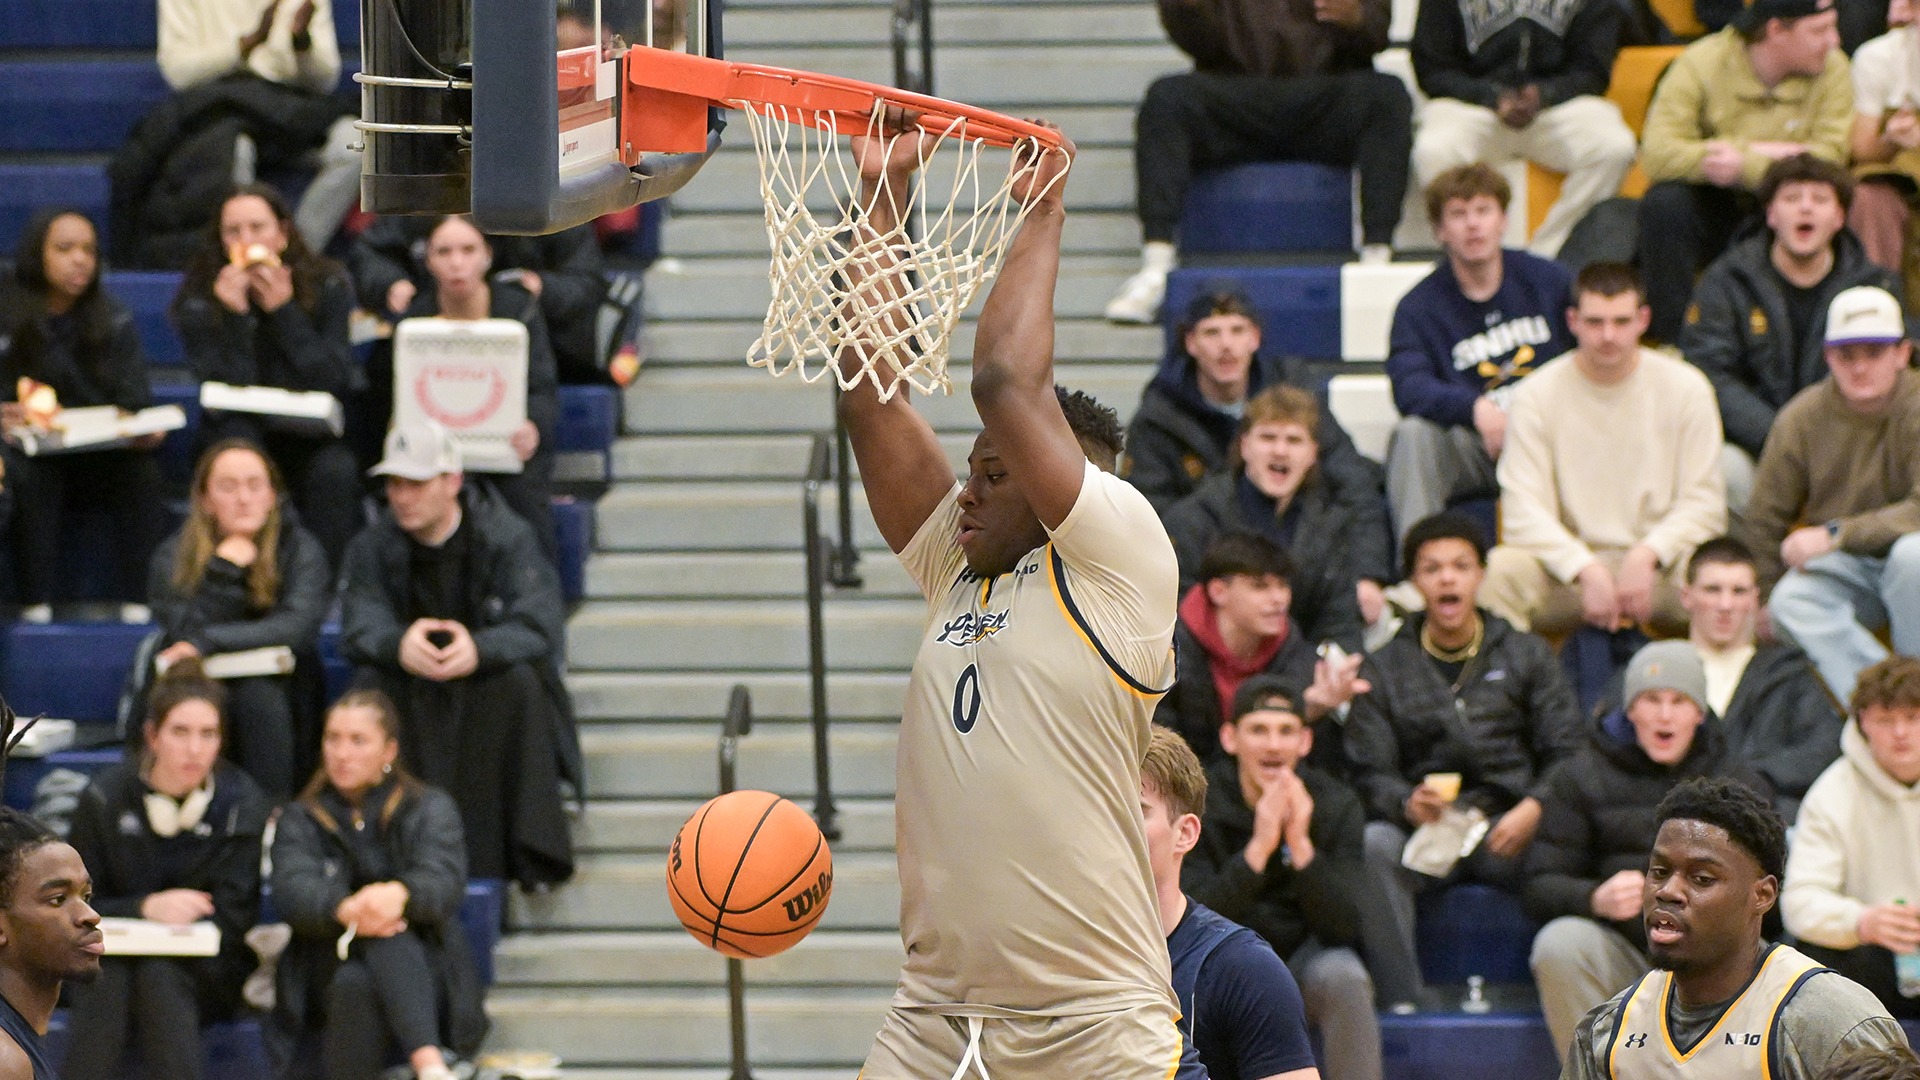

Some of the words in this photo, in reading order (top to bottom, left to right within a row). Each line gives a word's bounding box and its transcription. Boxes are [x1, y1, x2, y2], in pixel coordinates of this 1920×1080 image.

[1452, 315, 1551, 371] SNHU
[953, 662, 981, 735] 0
[1724, 1032, 1762, 1046] NE10
